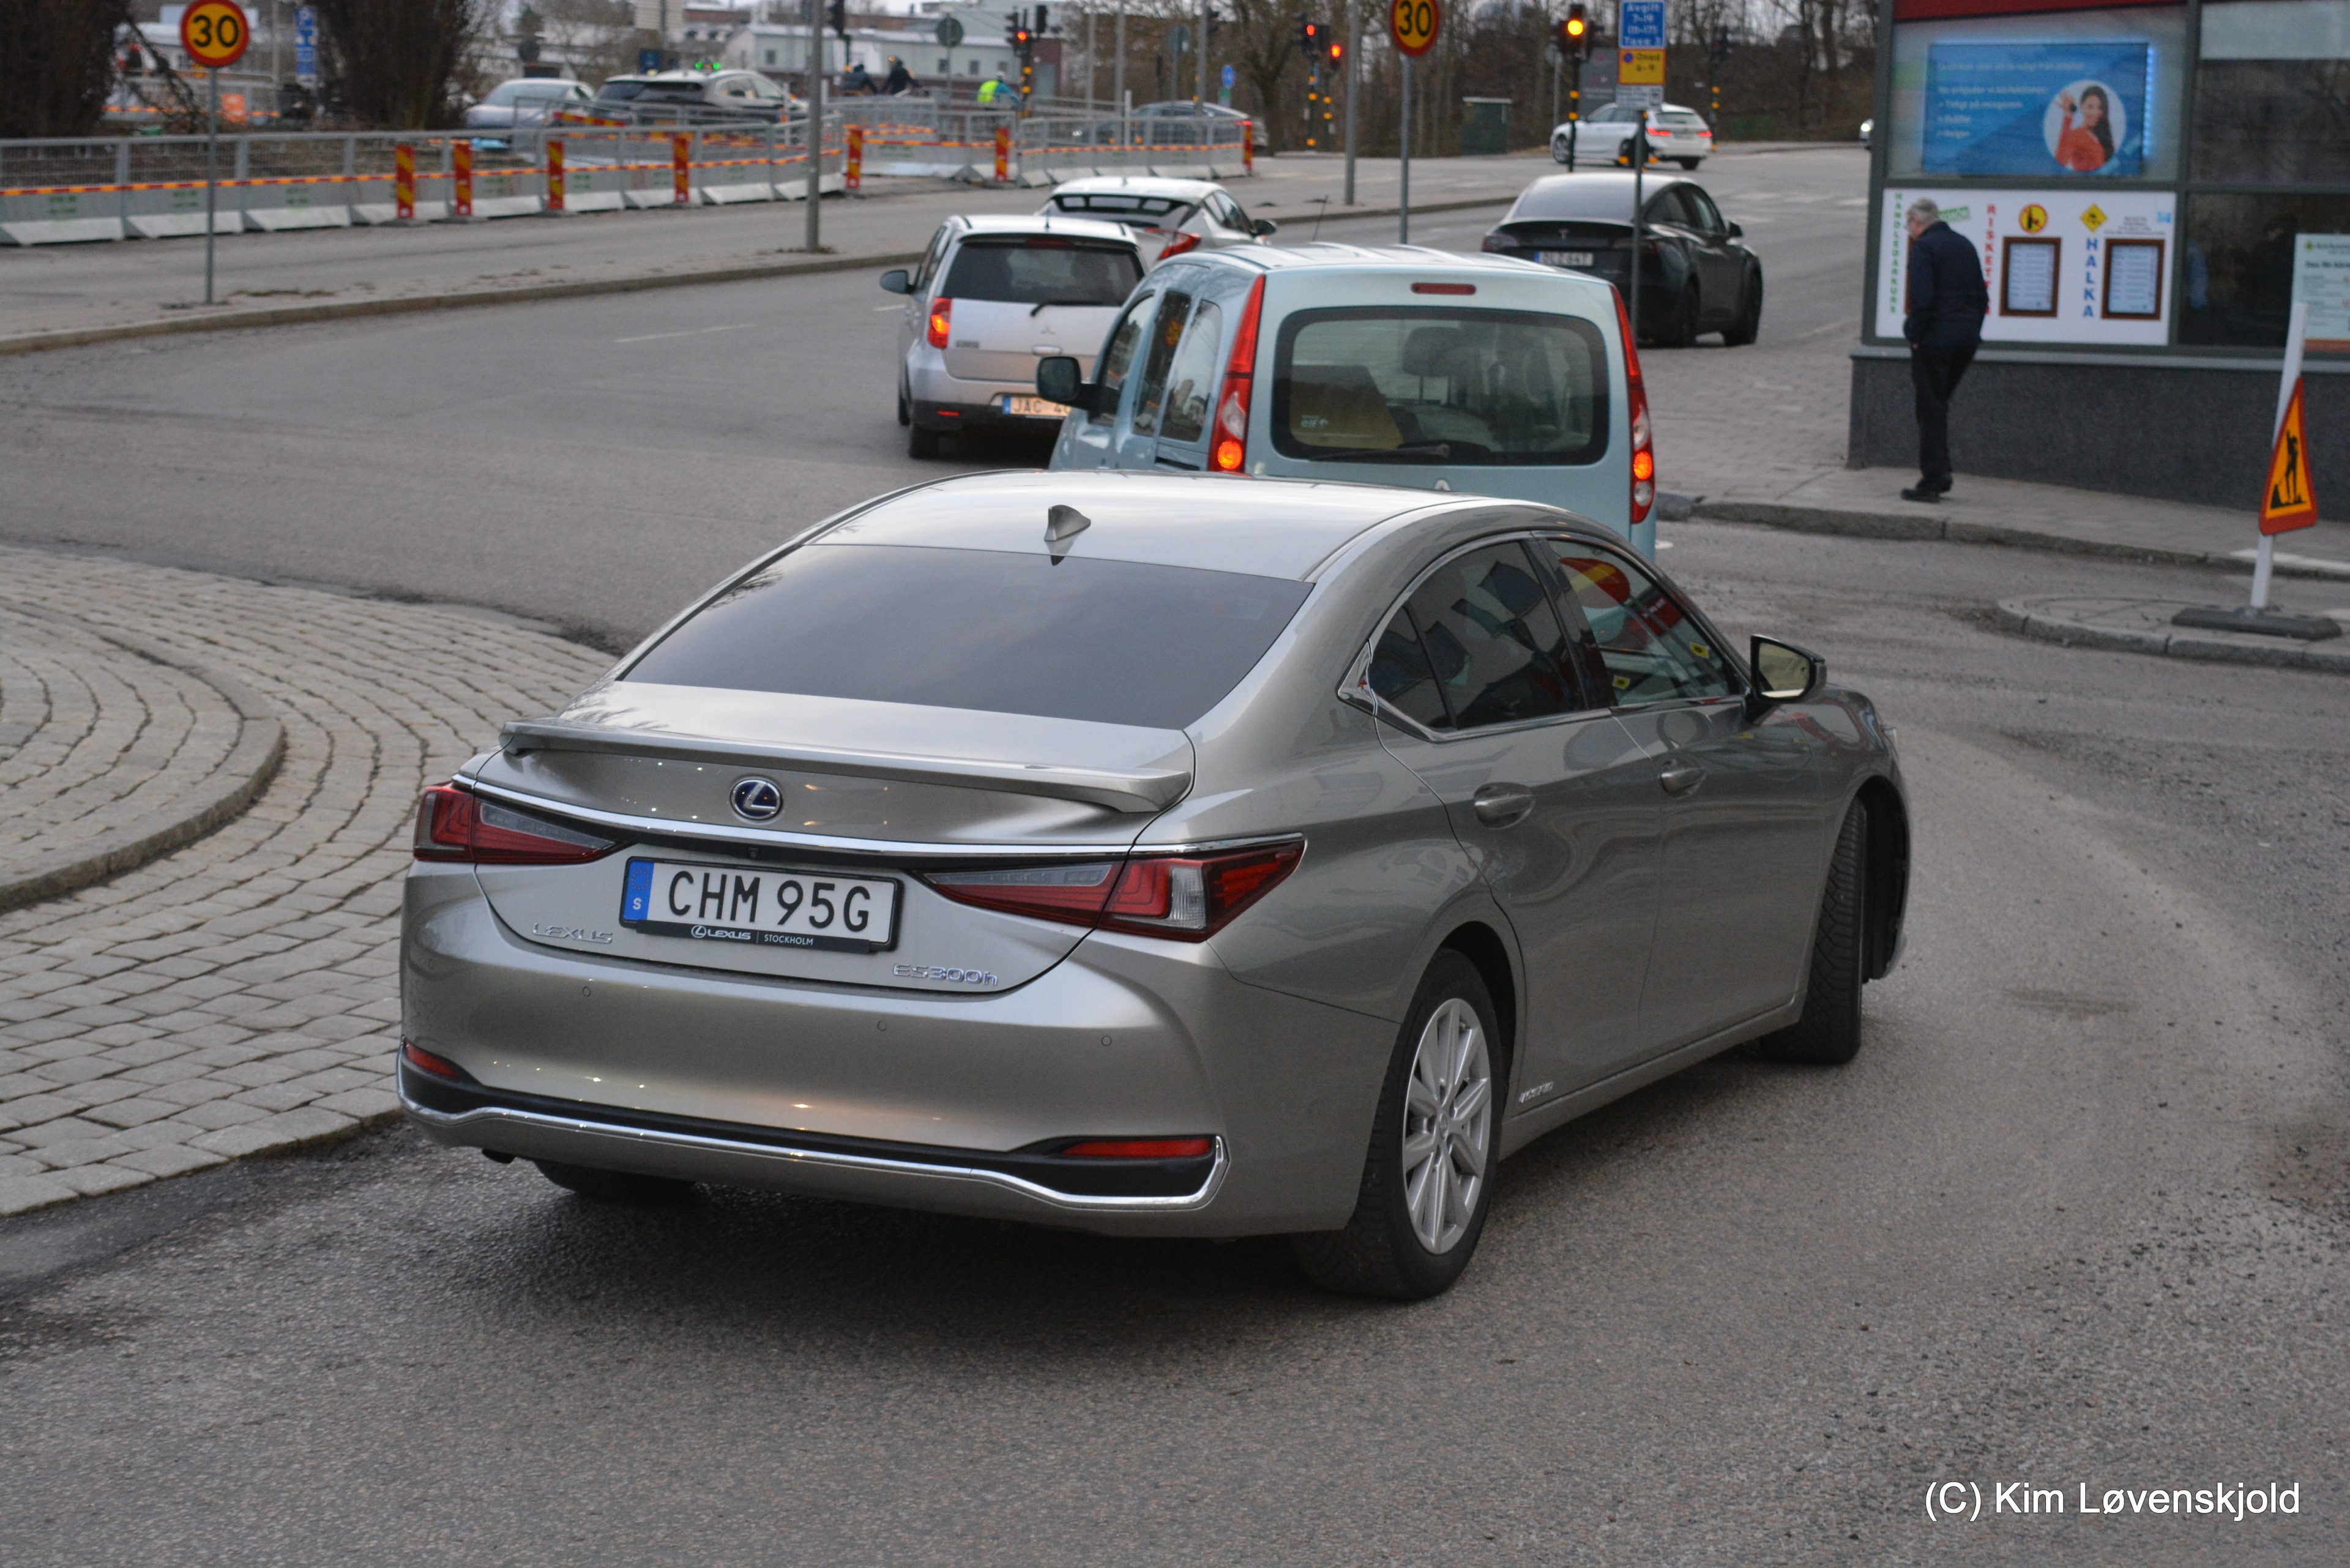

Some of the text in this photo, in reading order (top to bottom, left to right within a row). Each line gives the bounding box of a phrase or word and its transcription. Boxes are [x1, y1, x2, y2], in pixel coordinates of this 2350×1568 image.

[1399, 0, 1432, 37] 30
[1627, 3, 1660, 13] Avgift
[193, 15, 239, 48] 30
[2083, 238, 2098, 318] HALKA
[1013, 400, 1042, 413] JAC
[633, 897, 641, 911] S
[668, 870, 871, 933] CHM 95G
[532, 916, 613, 944] LEXUS
[707, 928, 814, 946] LEXUS STOCKHOLM
[893, 963, 998, 986] ES300h
